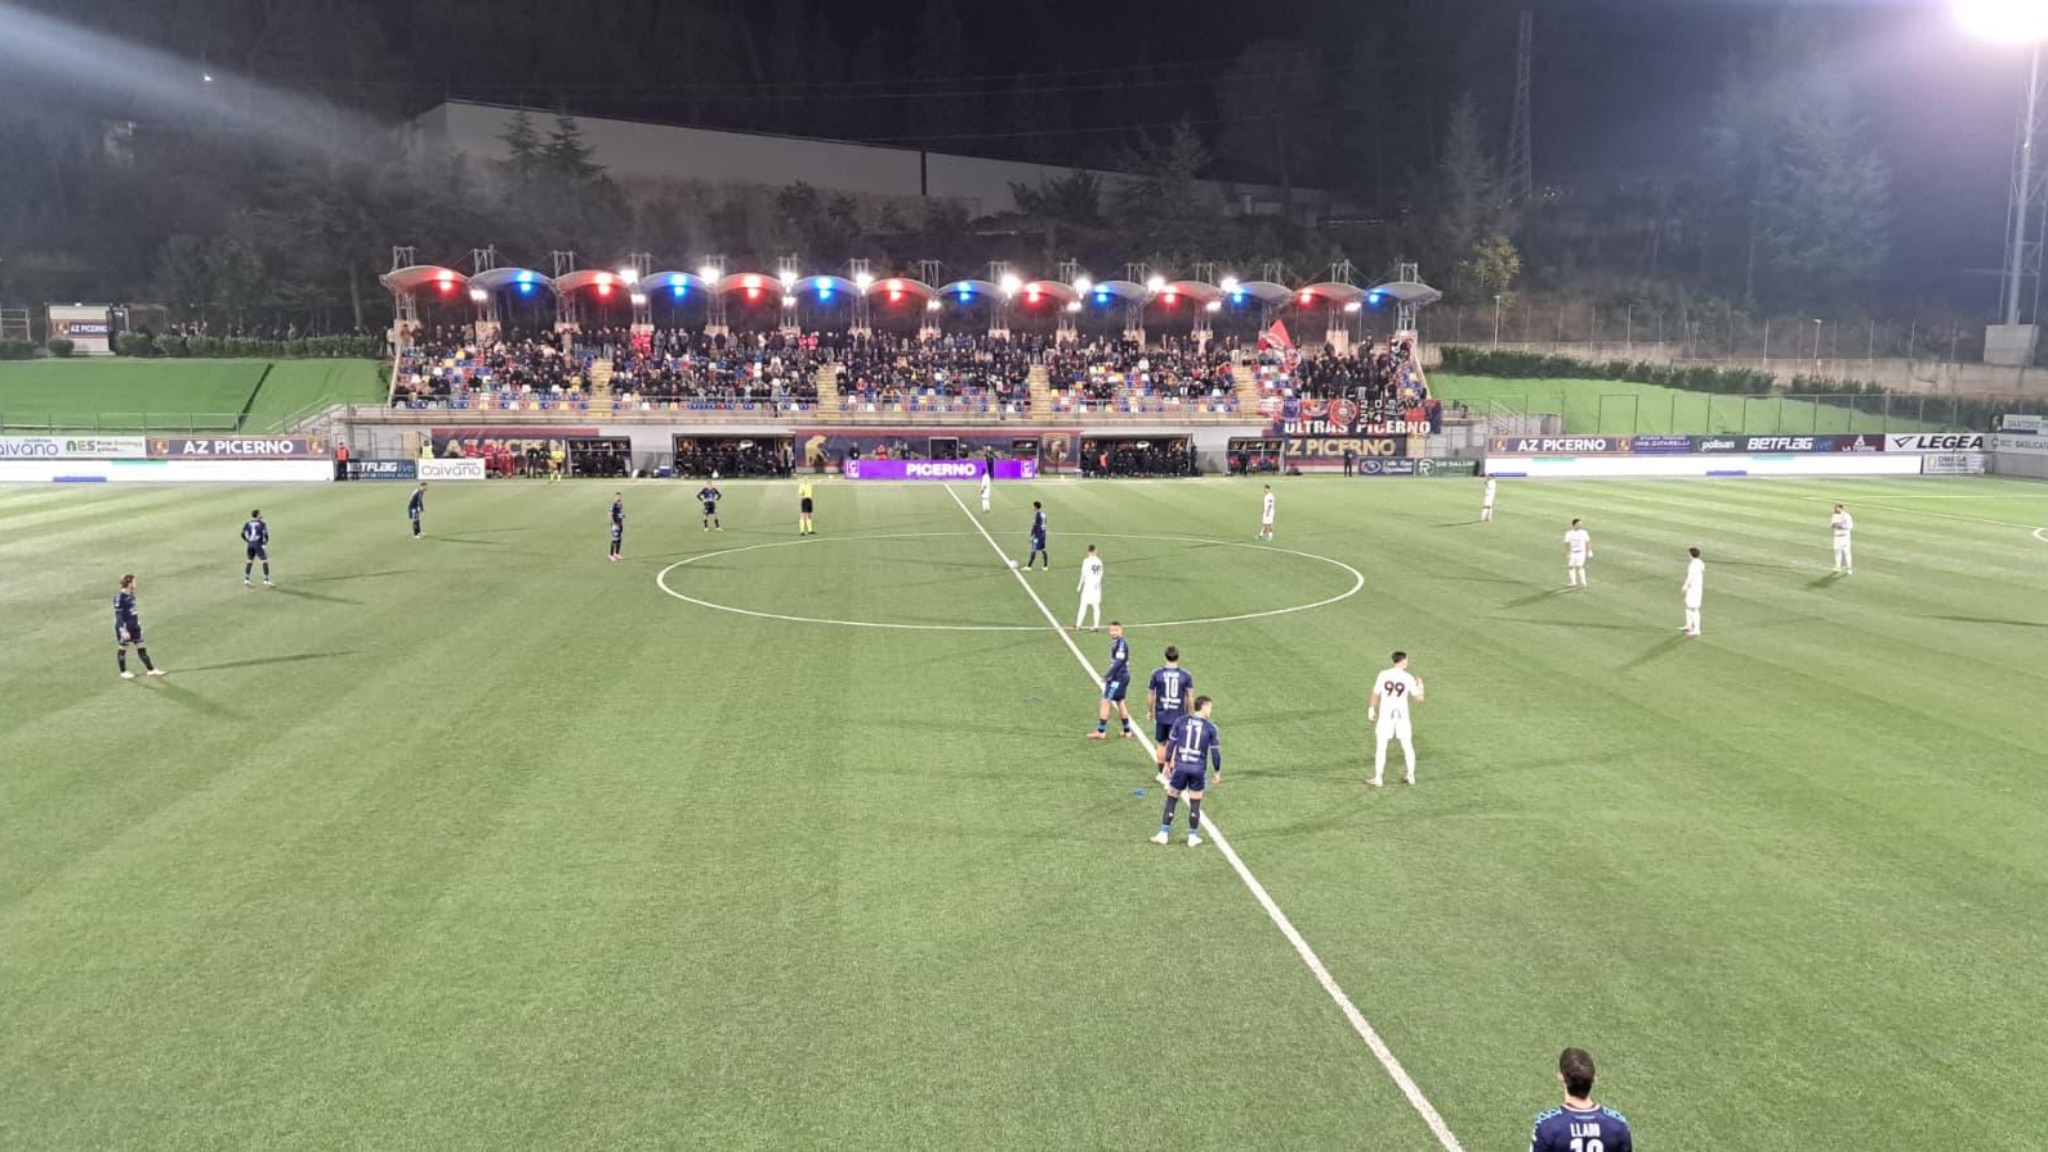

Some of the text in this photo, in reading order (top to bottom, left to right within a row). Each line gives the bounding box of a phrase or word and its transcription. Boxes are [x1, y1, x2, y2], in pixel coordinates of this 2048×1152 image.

[1284, 420, 1431, 434] ULTRAS PICERNO
[183, 440, 293, 454] AZ PICERNO
[1518, 439, 1606, 451] AZ PICERNO
[1916, 436, 1983, 449] LEGEA
[906, 463, 977, 476] PICERNO
[1164, 677, 1179, 698] 10
[1384, 680, 1405, 697] 99
[1186, 725, 1203, 750] 11
